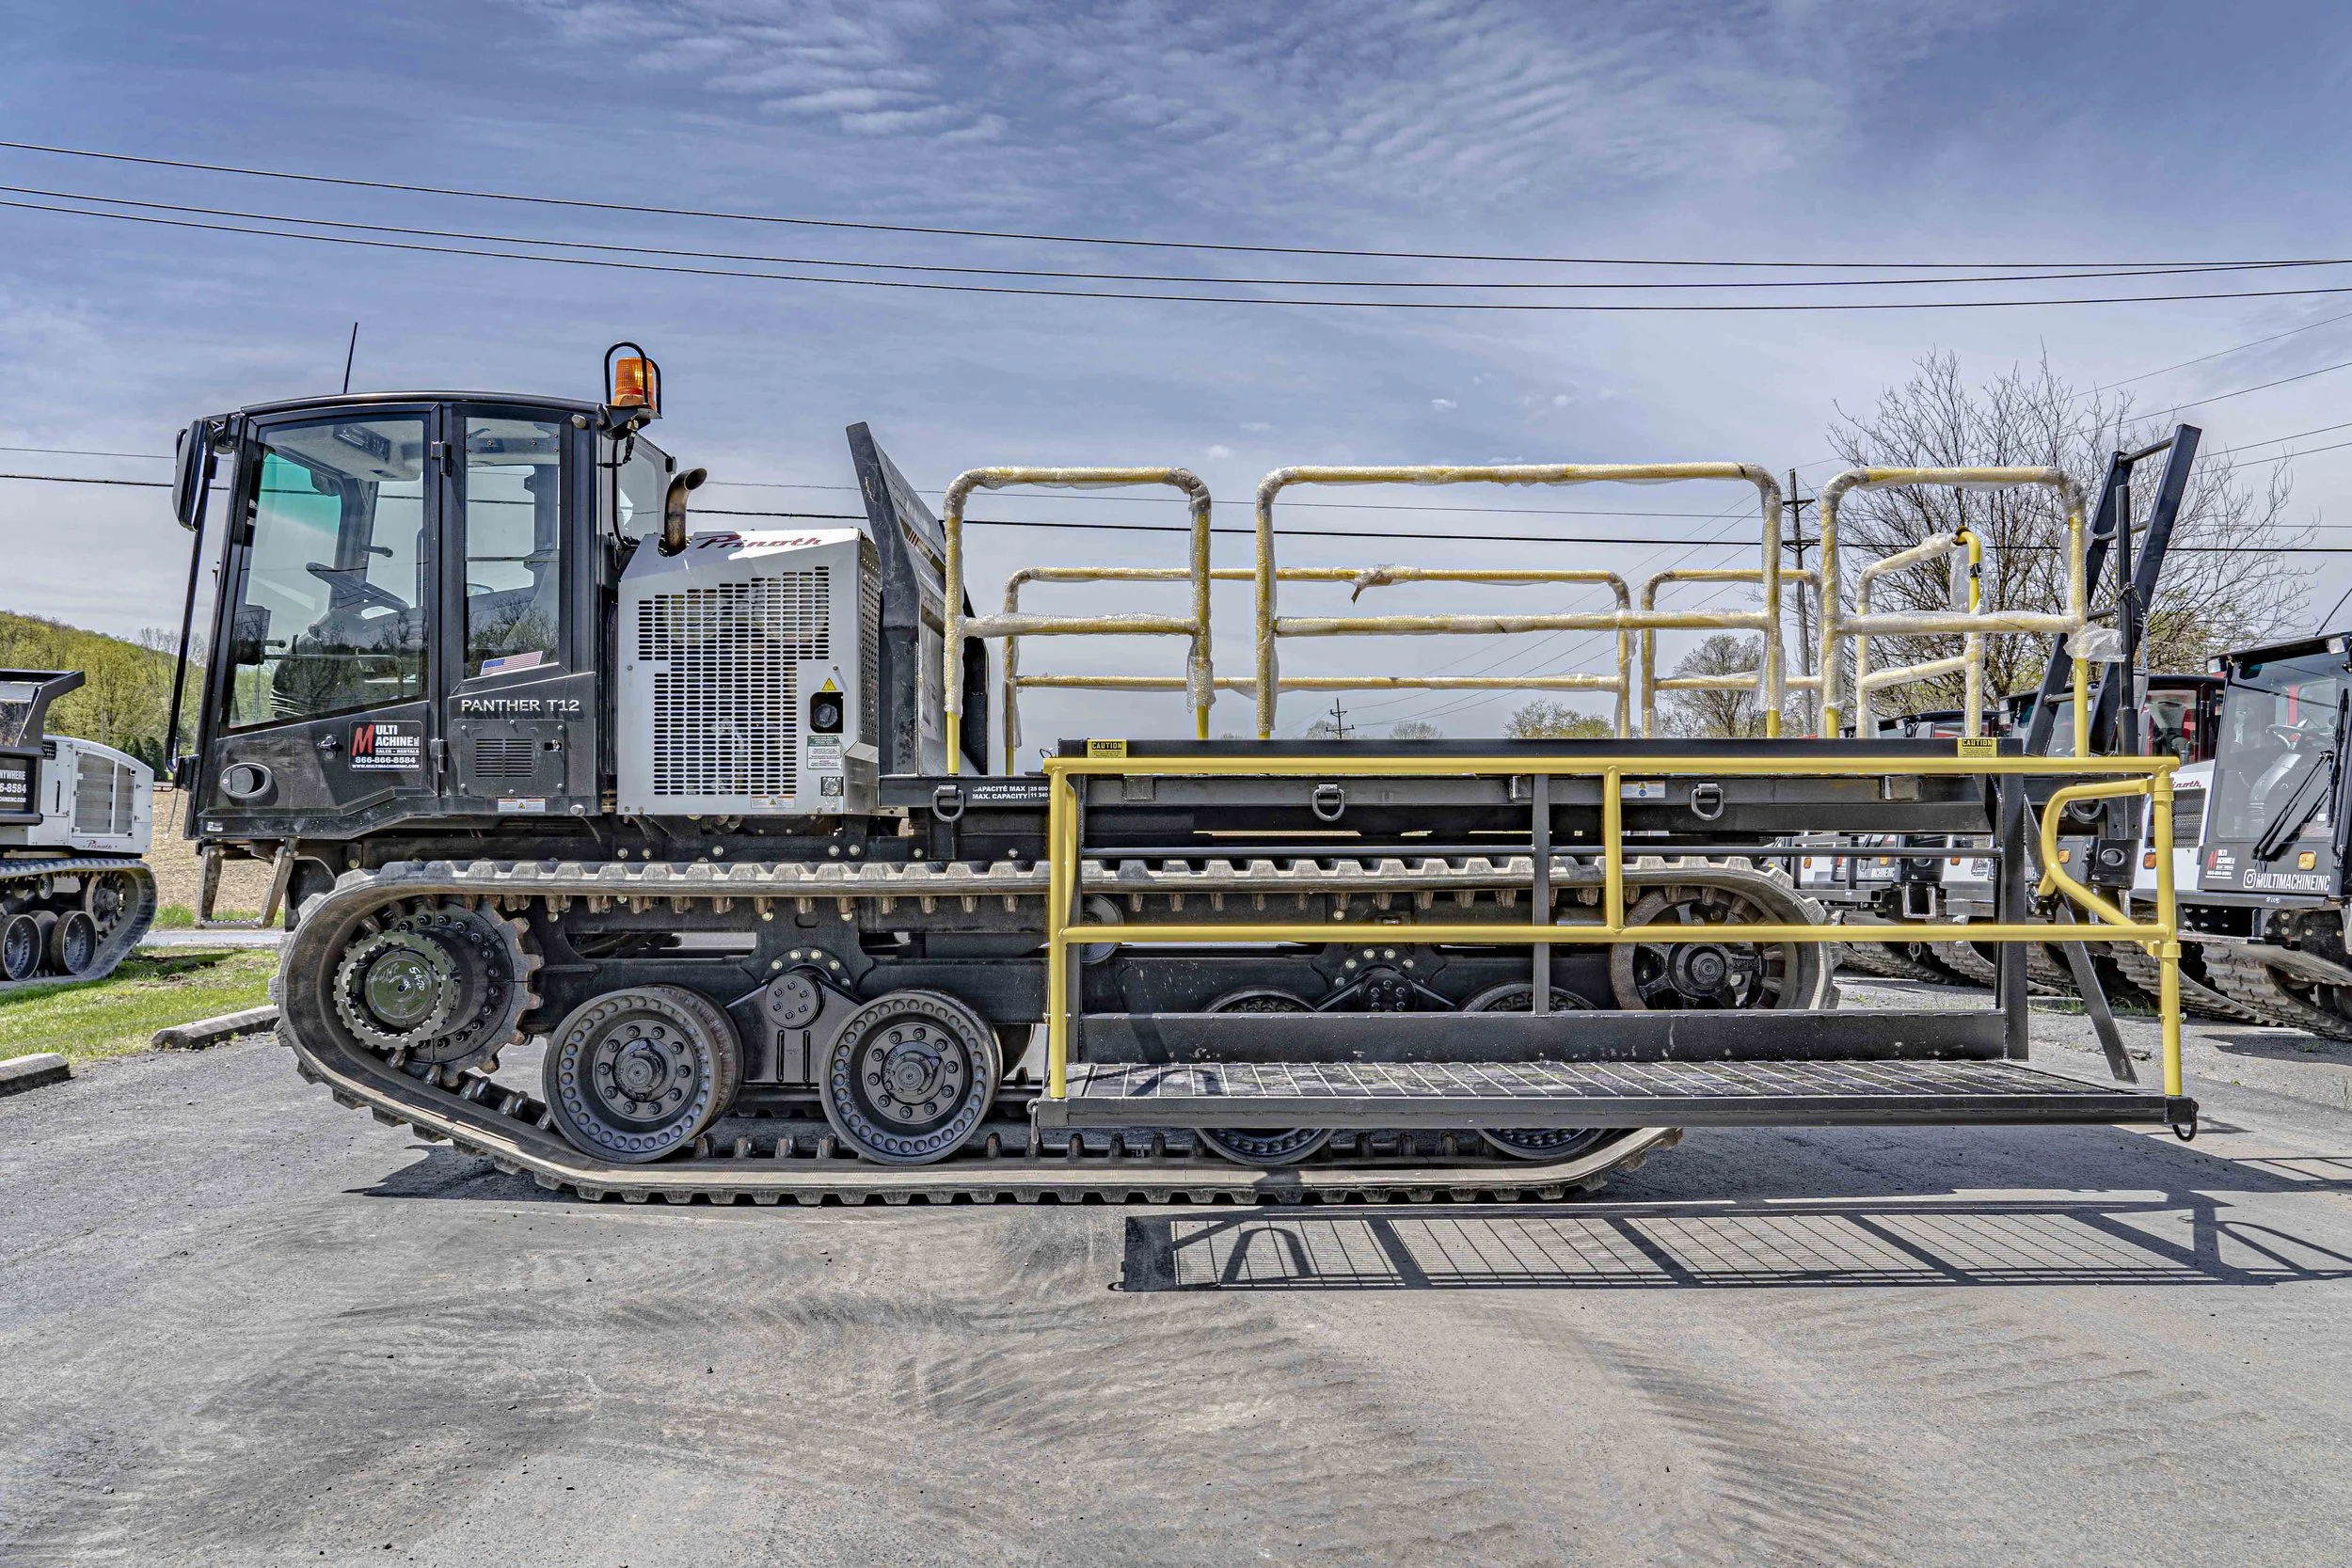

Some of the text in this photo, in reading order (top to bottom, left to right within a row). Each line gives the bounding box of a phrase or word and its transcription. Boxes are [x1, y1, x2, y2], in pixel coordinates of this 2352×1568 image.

[461, 699, 580, 712] PANTHER T12
[2256, 872, 2331, 892] MULTIMACHINEINC
